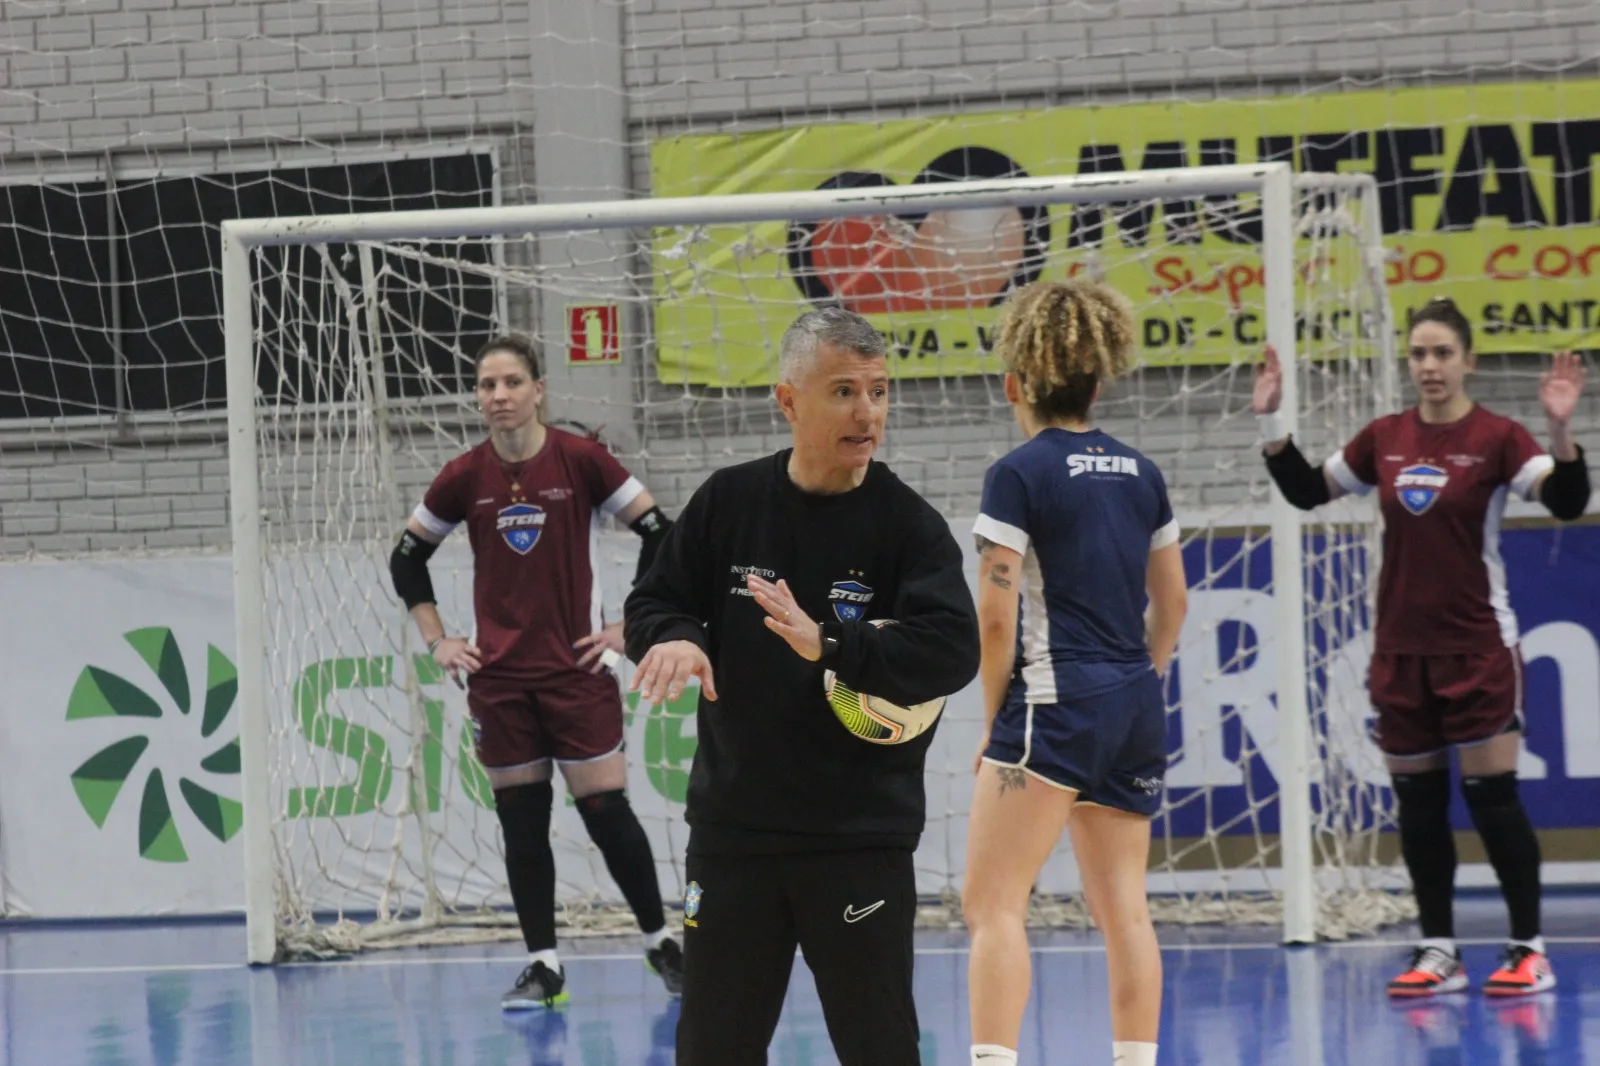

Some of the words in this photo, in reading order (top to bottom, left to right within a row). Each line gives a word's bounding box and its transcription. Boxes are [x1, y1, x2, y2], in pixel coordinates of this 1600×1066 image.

[1068, 120, 1600, 248] MUFFAT
[1482, 300, 1600, 335] SANT
[1066, 453, 1139, 477] STEIN
[730, 565, 776, 578] INSTITUTO
